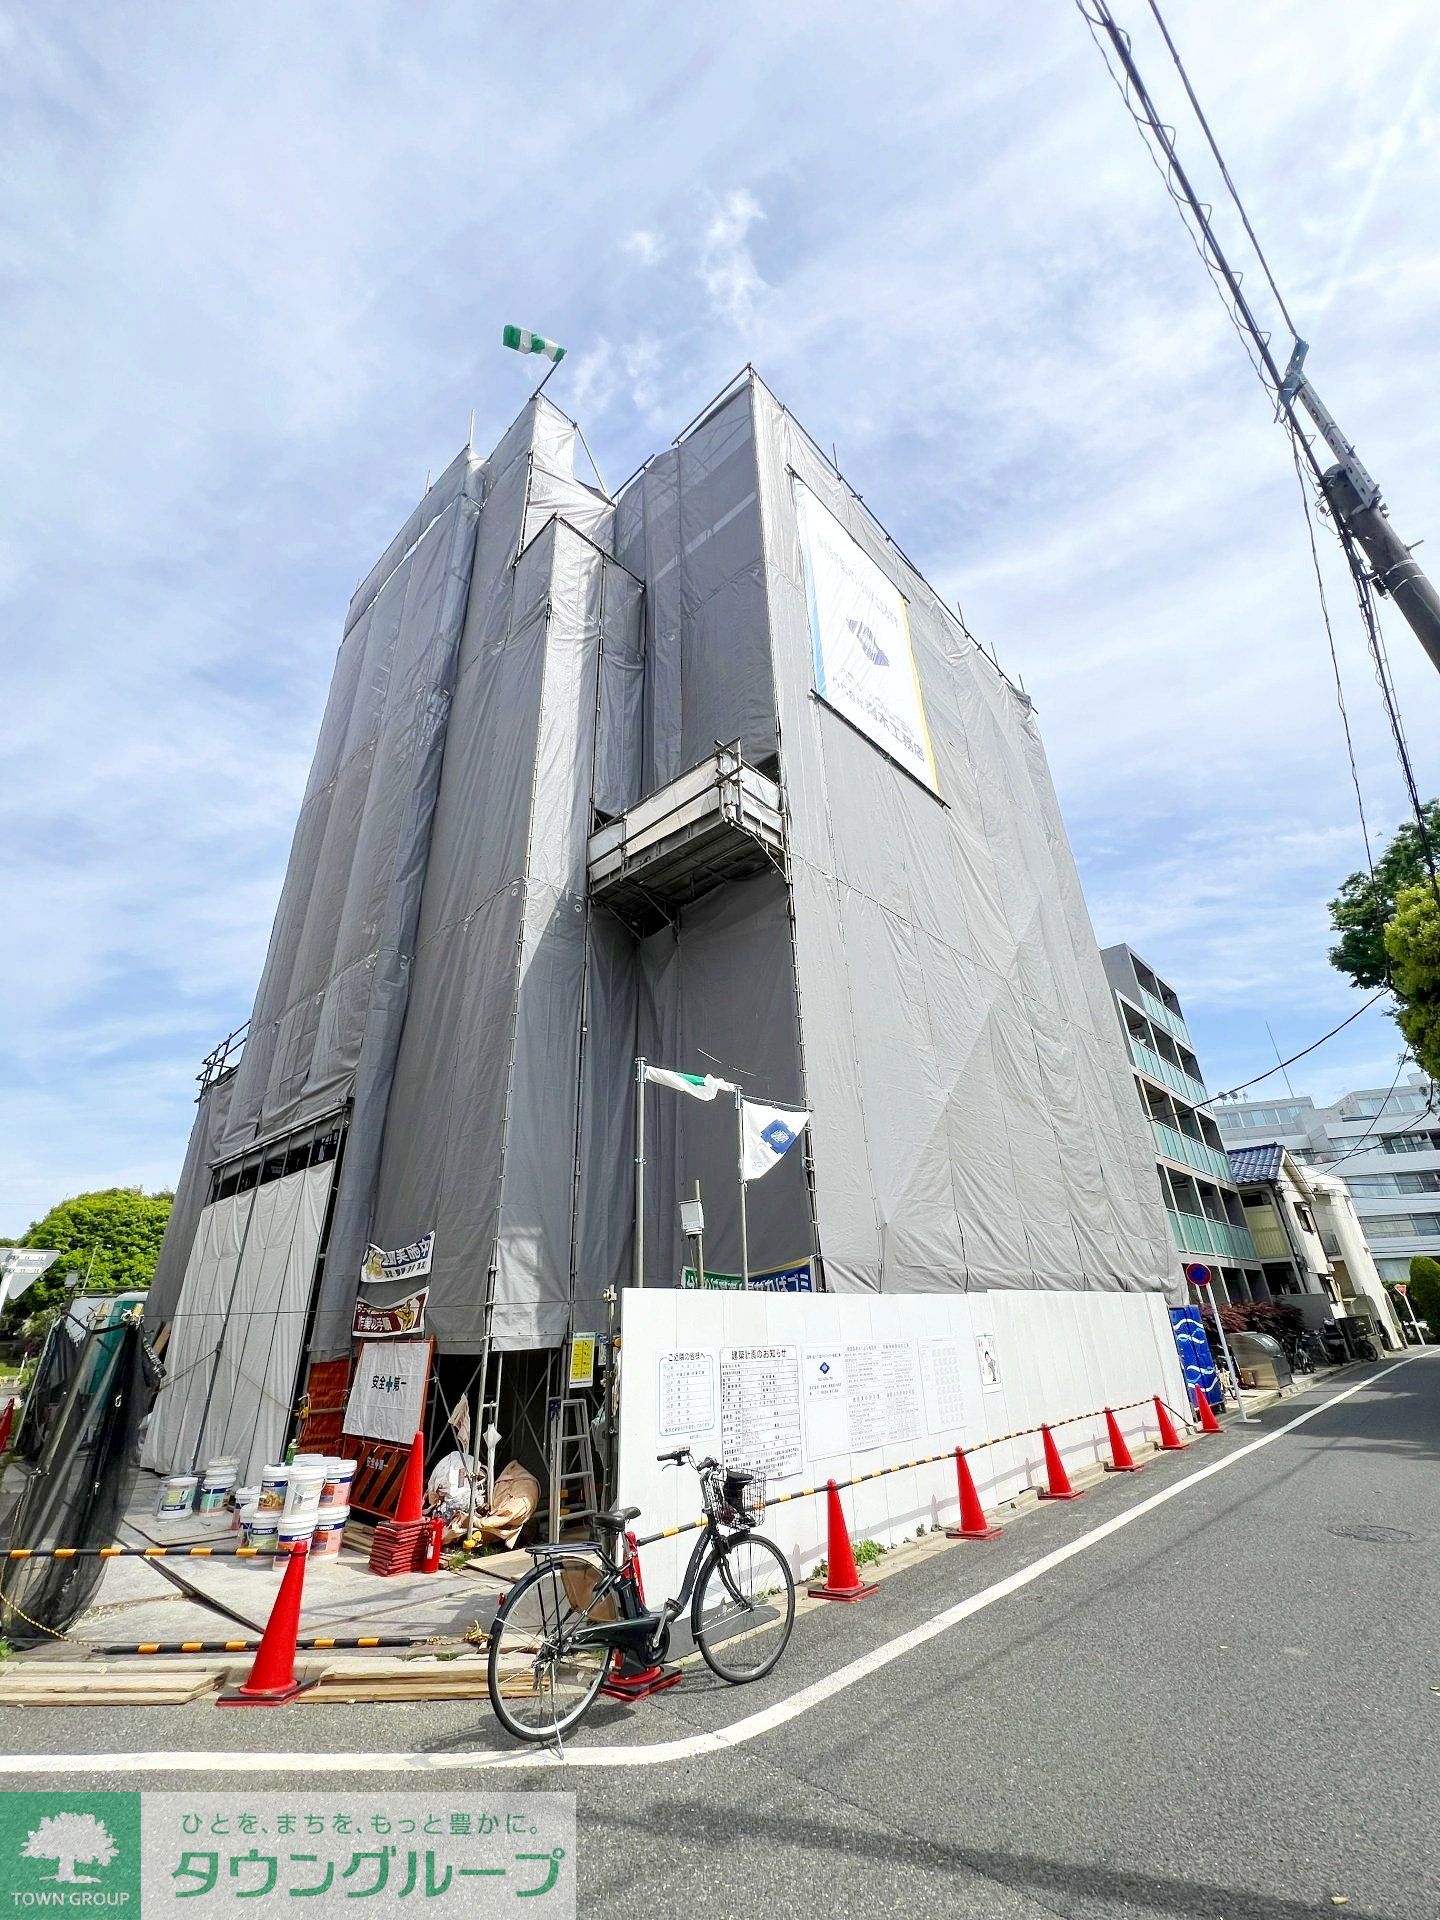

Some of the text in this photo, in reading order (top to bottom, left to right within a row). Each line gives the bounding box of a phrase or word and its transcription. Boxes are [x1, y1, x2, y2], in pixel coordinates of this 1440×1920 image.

[732, 1348, 787, 1360] 建築計画のお知らせ
